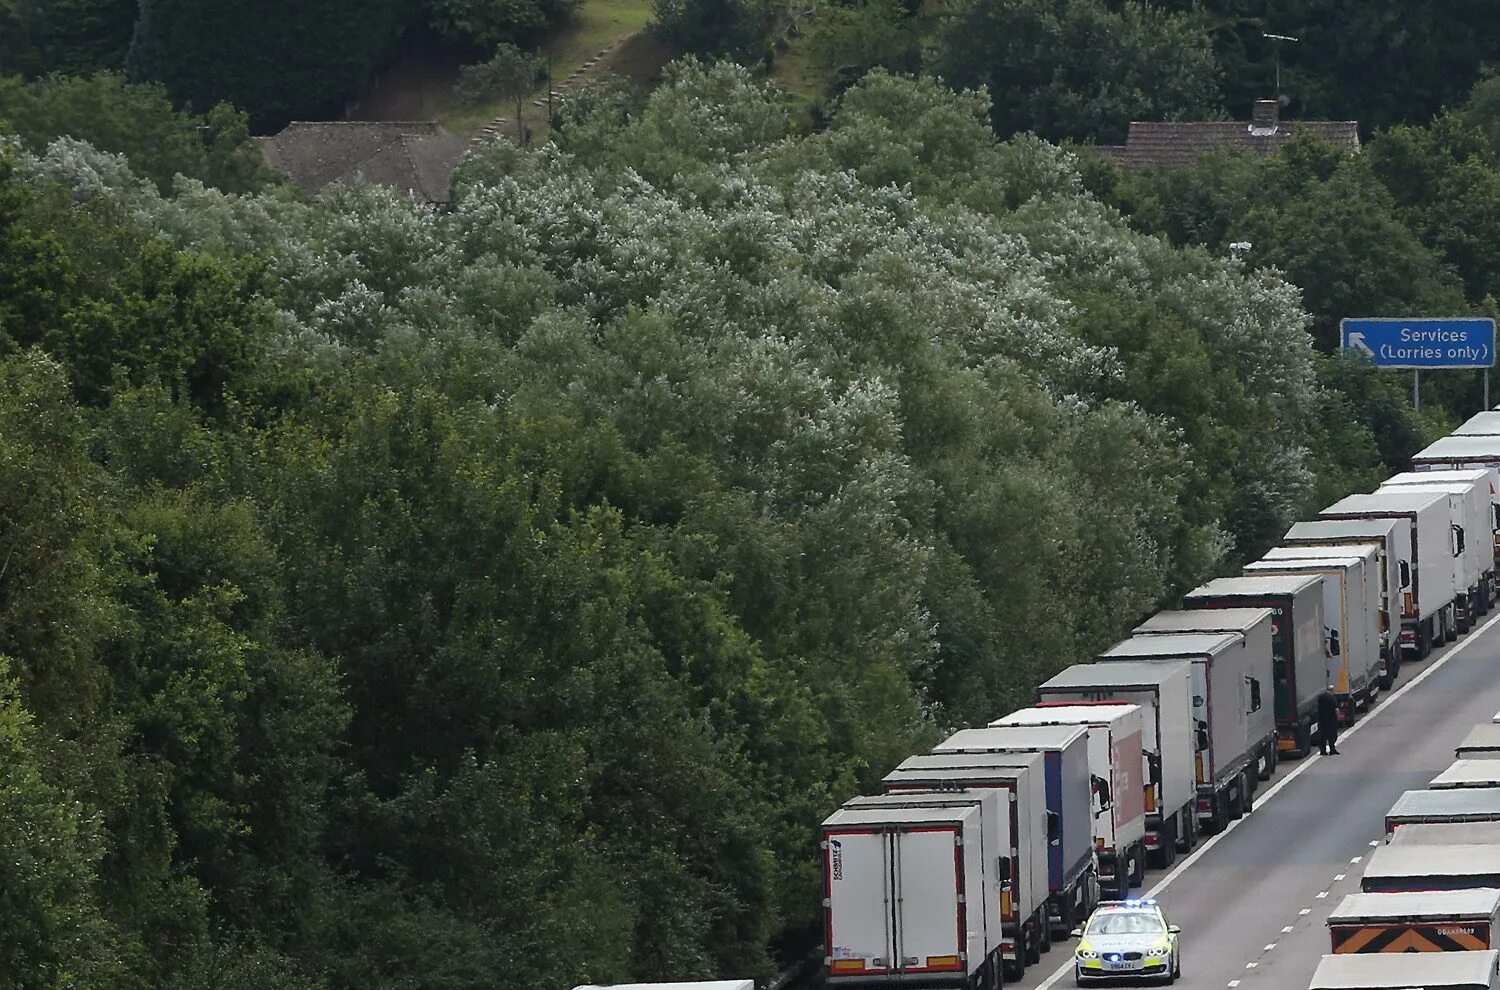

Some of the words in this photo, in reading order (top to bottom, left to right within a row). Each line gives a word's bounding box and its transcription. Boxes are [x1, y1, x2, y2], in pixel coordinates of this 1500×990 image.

[1400, 328, 1468, 342] Services
[1380, 344, 1442, 359] (Lorries
[1447, 344, 1488, 360] only)
